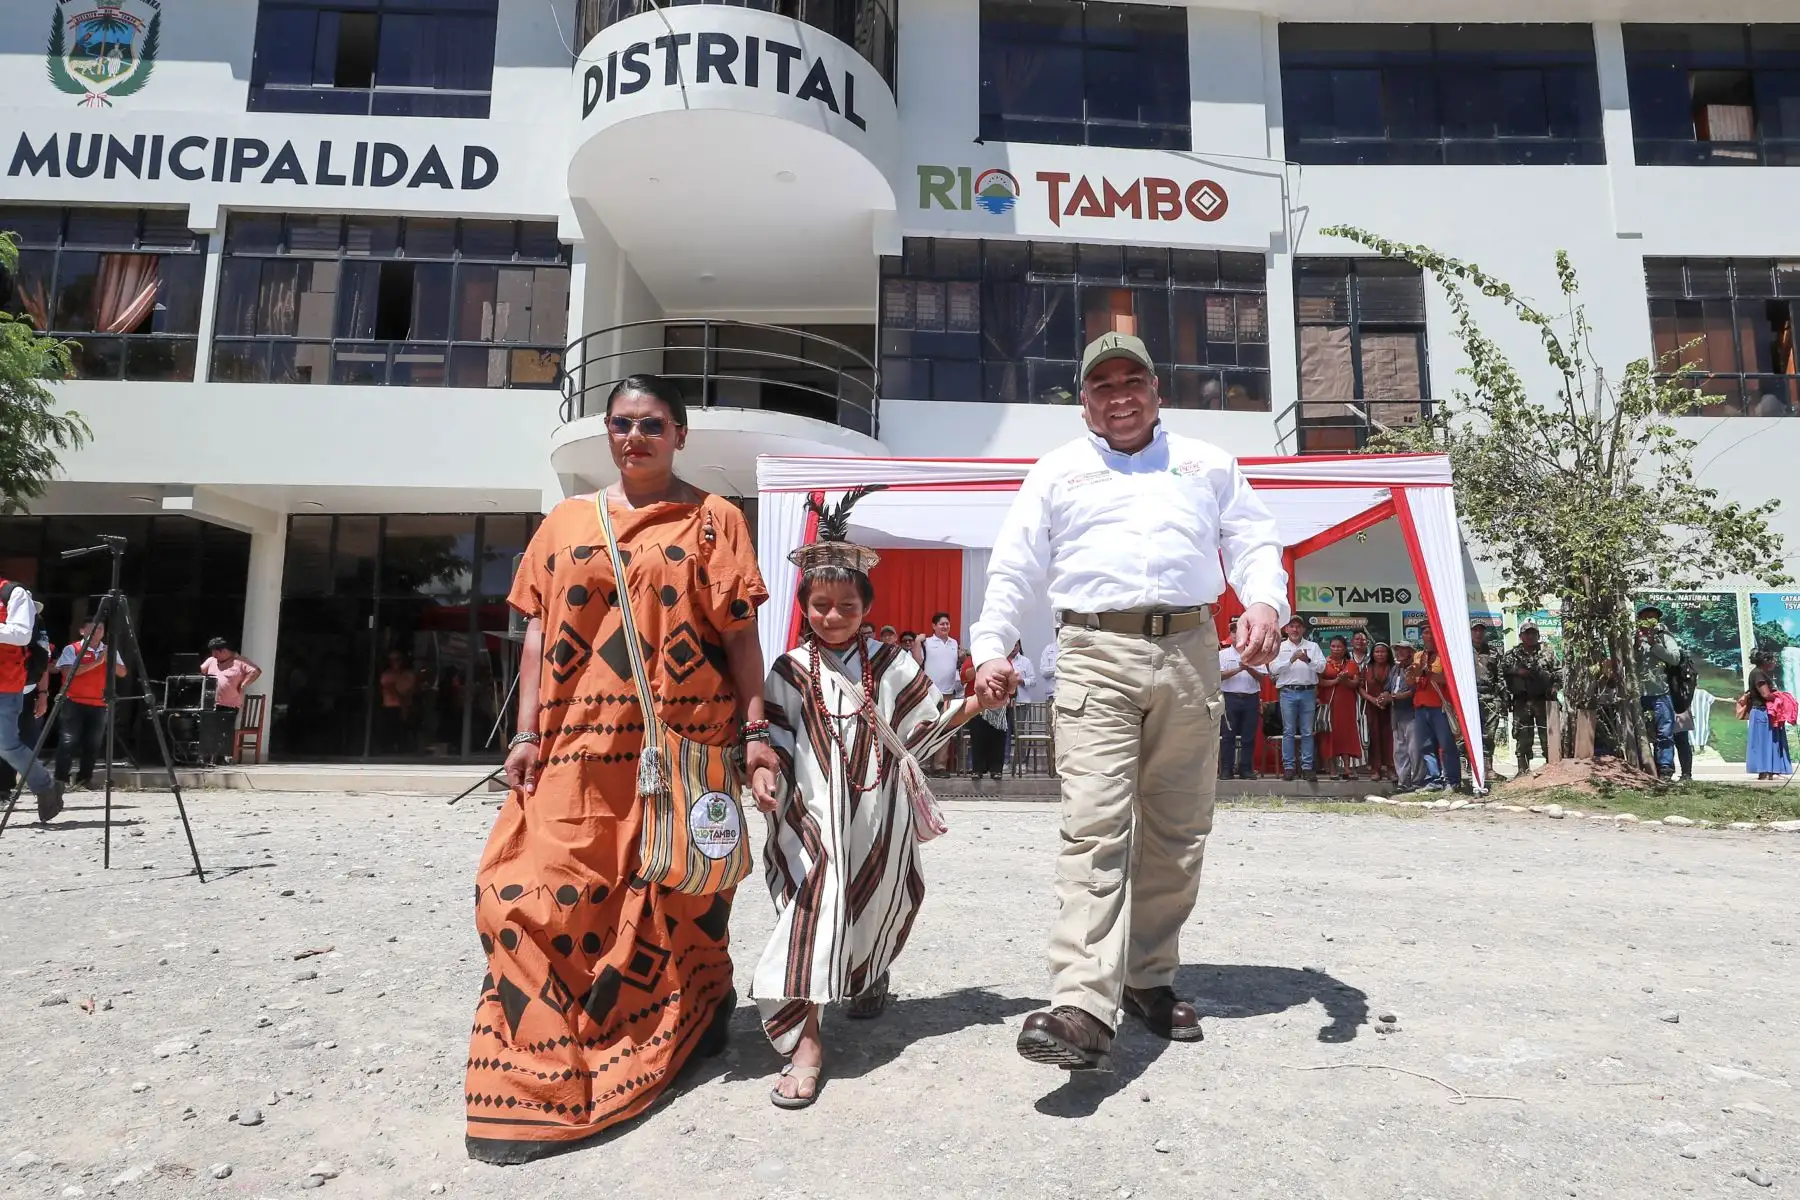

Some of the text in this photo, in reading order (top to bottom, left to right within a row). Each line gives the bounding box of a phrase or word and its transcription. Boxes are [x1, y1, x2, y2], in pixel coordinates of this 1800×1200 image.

[581, 32, 867, 133] DISTRITAL
[7, 130, 500, 191] MUNICIPALIDAD
[916, 164, 1229, 229] RIO TAMBO
[1678, 594, 1711, 602] NATURAL
